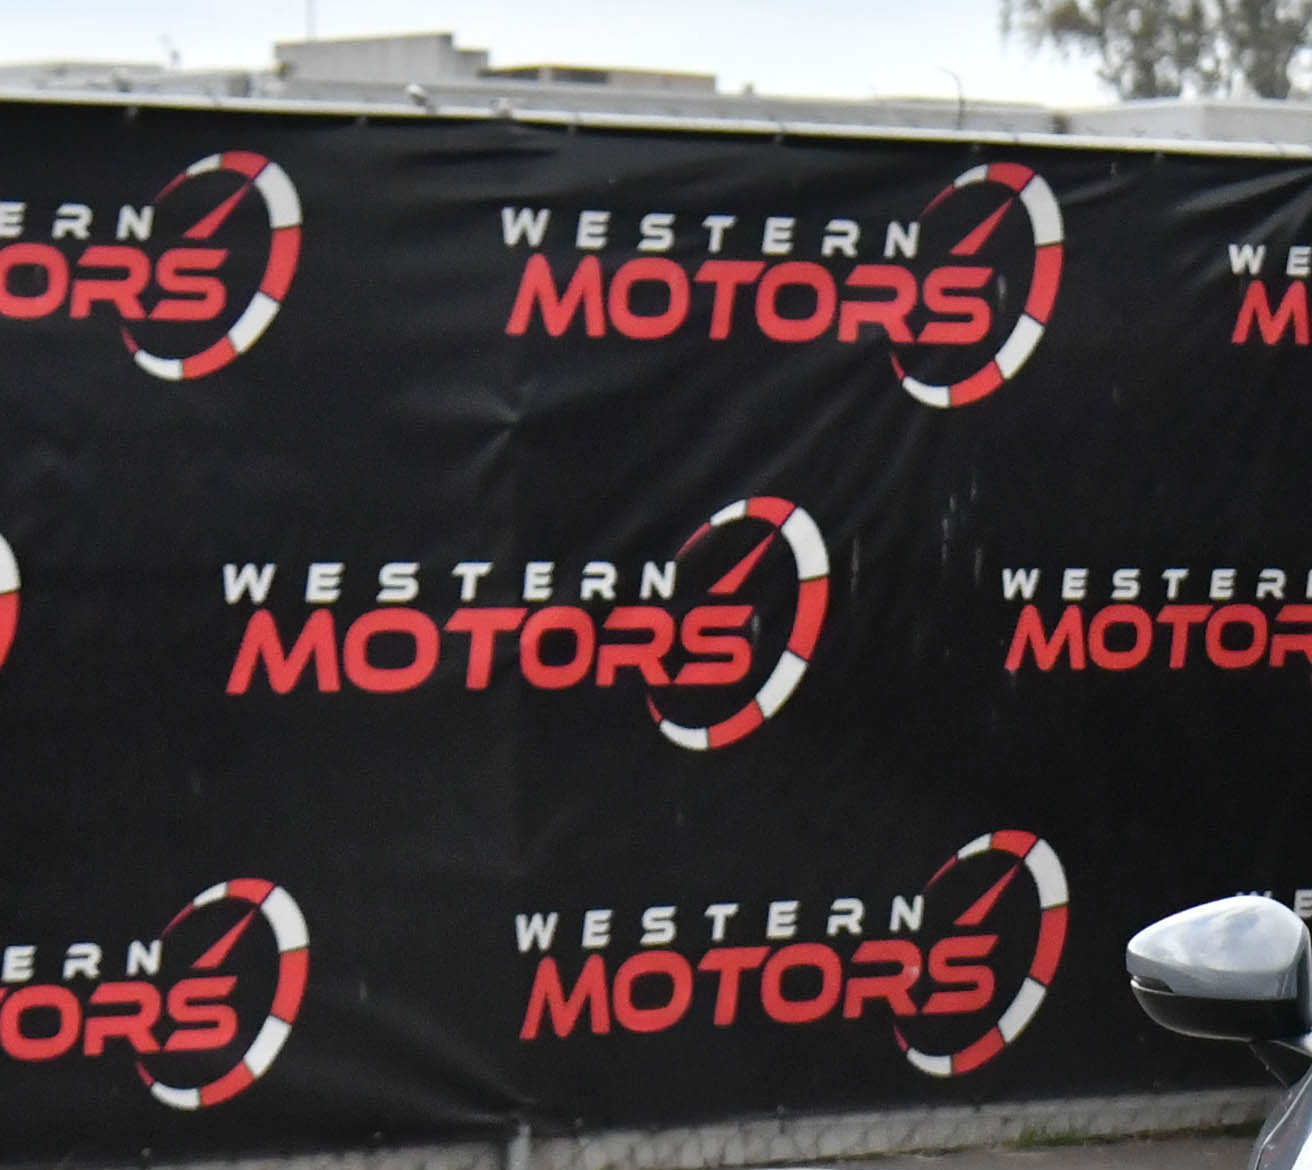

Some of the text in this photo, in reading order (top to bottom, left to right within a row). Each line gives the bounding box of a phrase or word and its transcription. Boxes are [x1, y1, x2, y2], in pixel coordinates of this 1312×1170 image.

[501, 207, 919, 258] WESTERN
[505, 253, 993, 345] MOTORS
[223, 561, 677, 604] WESTERN
[226, 605, 753, 695] MOTORS
[515, 895, 924, 952] WESTERN
[520, 934, 997, 1041] MOTORS
